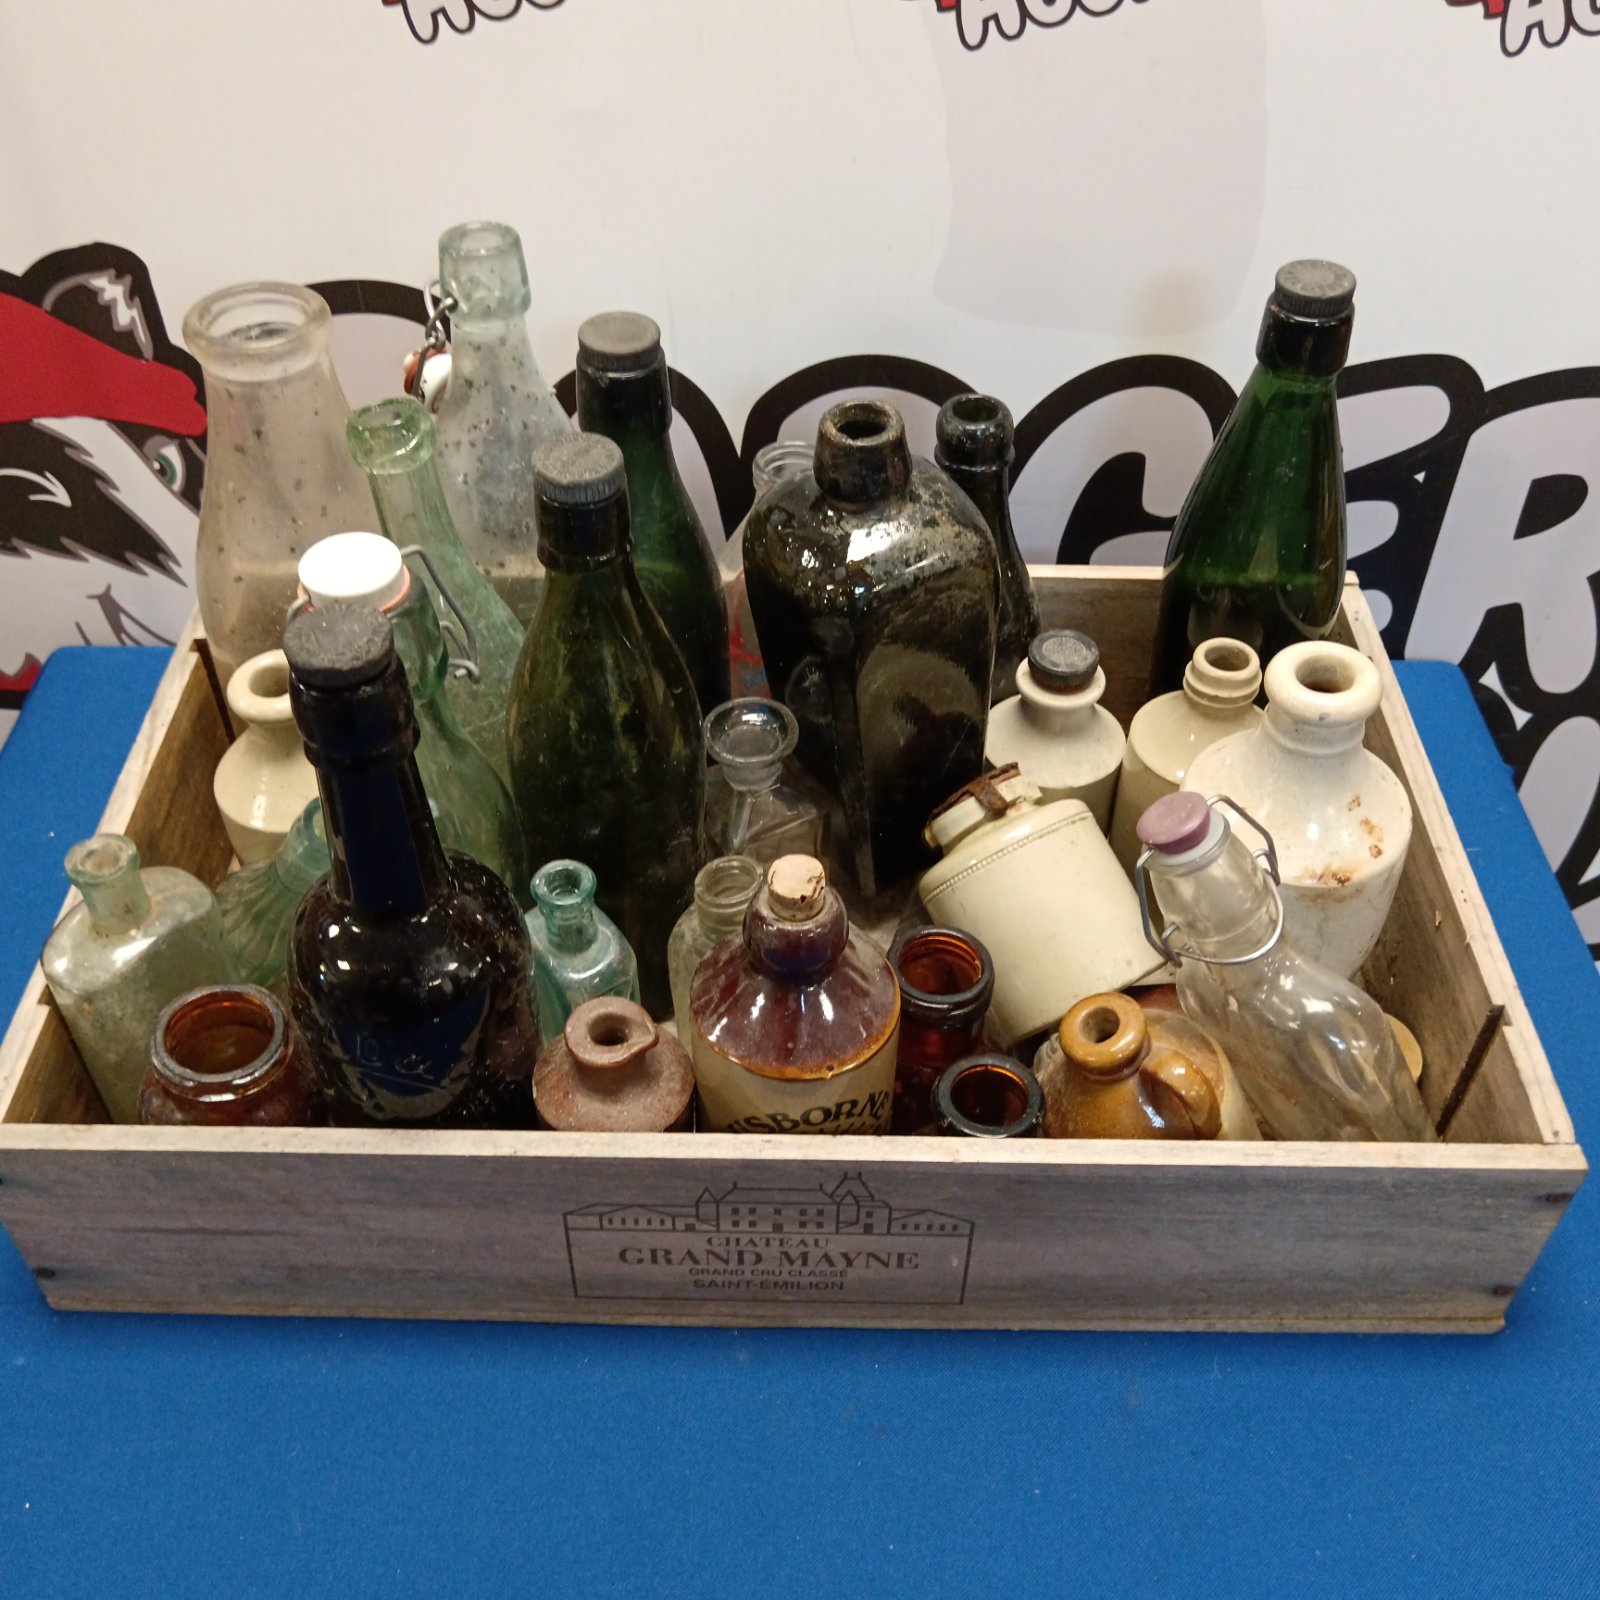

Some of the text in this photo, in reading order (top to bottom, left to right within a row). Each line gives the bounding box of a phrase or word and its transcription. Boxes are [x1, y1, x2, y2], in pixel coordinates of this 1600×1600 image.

[706, 1235, 830, 1249] CHATEAU
[618, 1247, 920, 1270] GRAND MAYNE
[688, 1267, 745, 1277] GRAND
[750, 1268, 783, 1278] CRU
